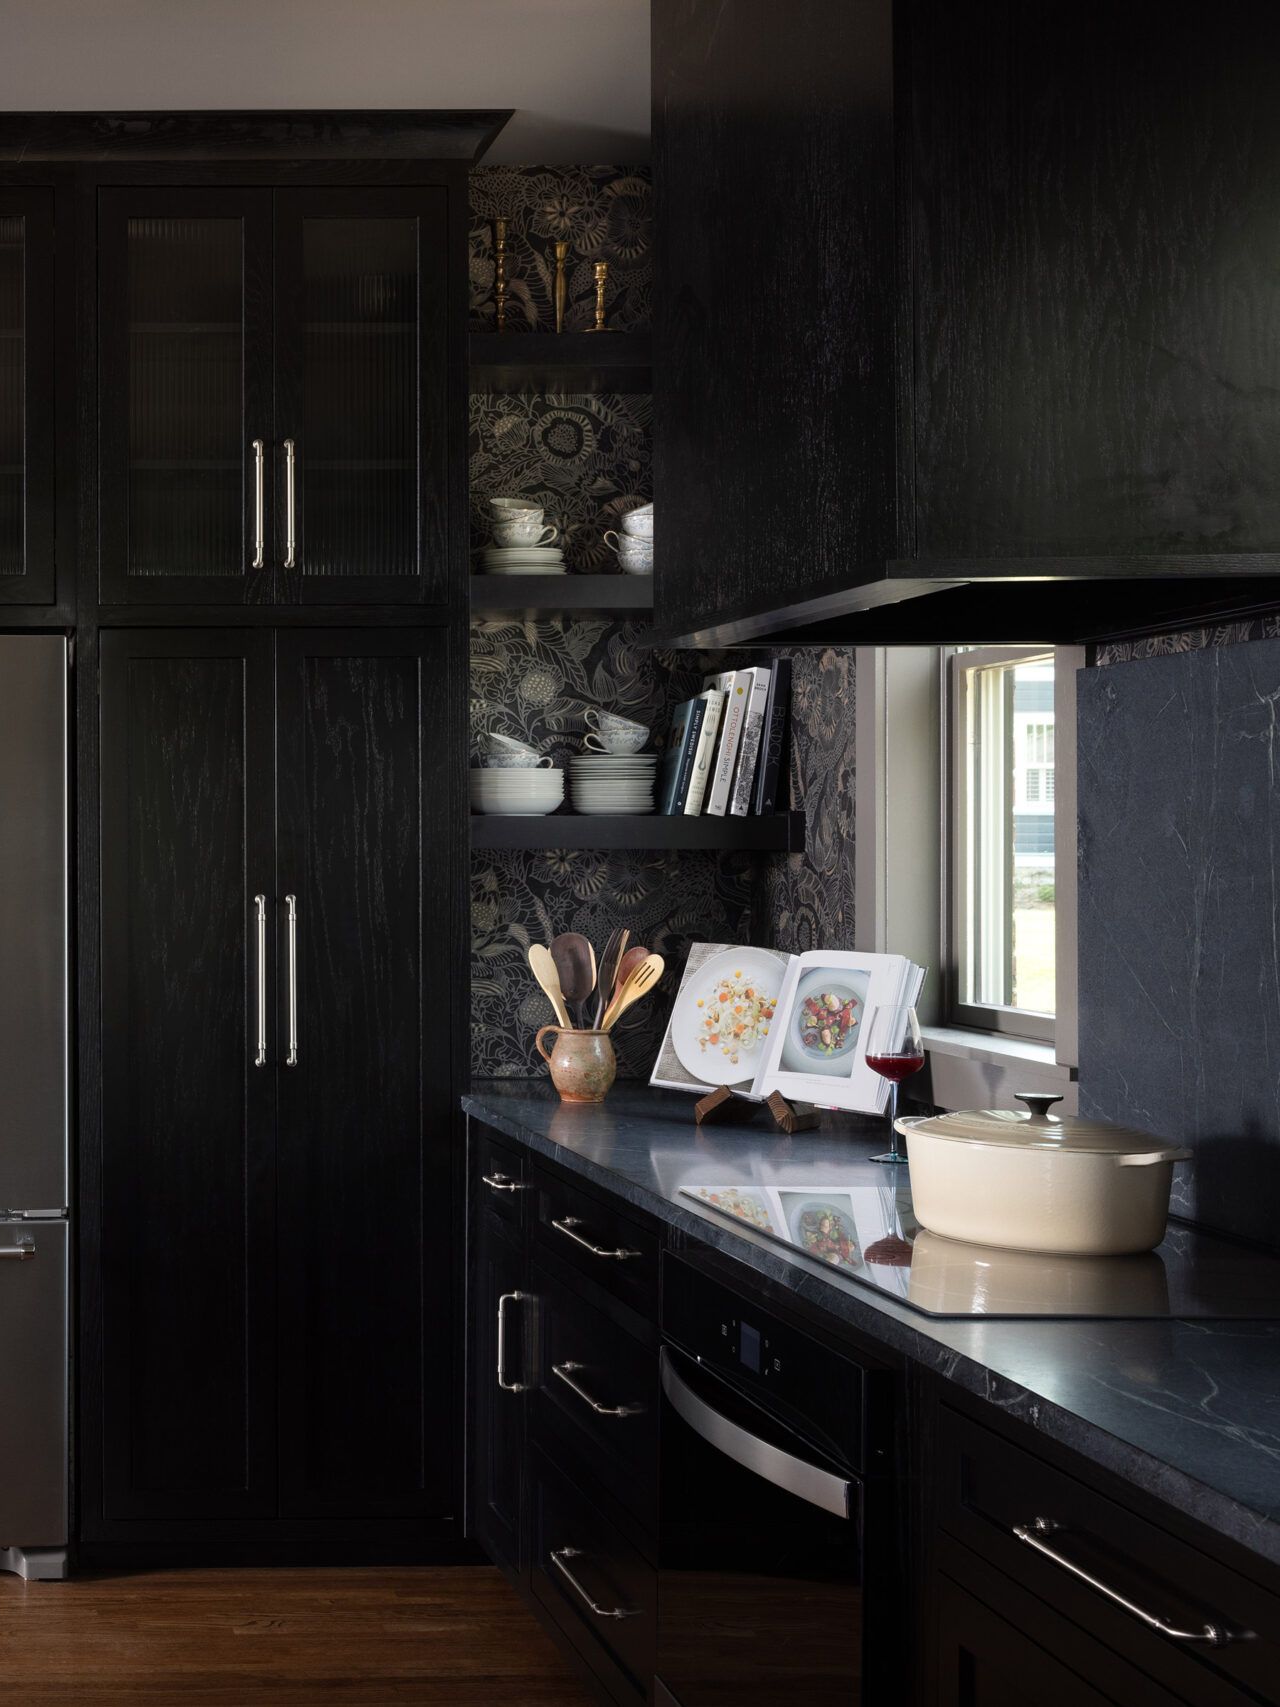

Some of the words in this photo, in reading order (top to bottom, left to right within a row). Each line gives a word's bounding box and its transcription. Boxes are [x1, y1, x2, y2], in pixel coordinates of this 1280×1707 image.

[693, 710, 701, 729] SIMPLY
[726, 706, 740, 757] OTTOLENGHI
[688, 731, 697, 755] SWEDISH
[768, 705, 786, 768] BROCK
[719, 757, 729, 783] SIMPLE
